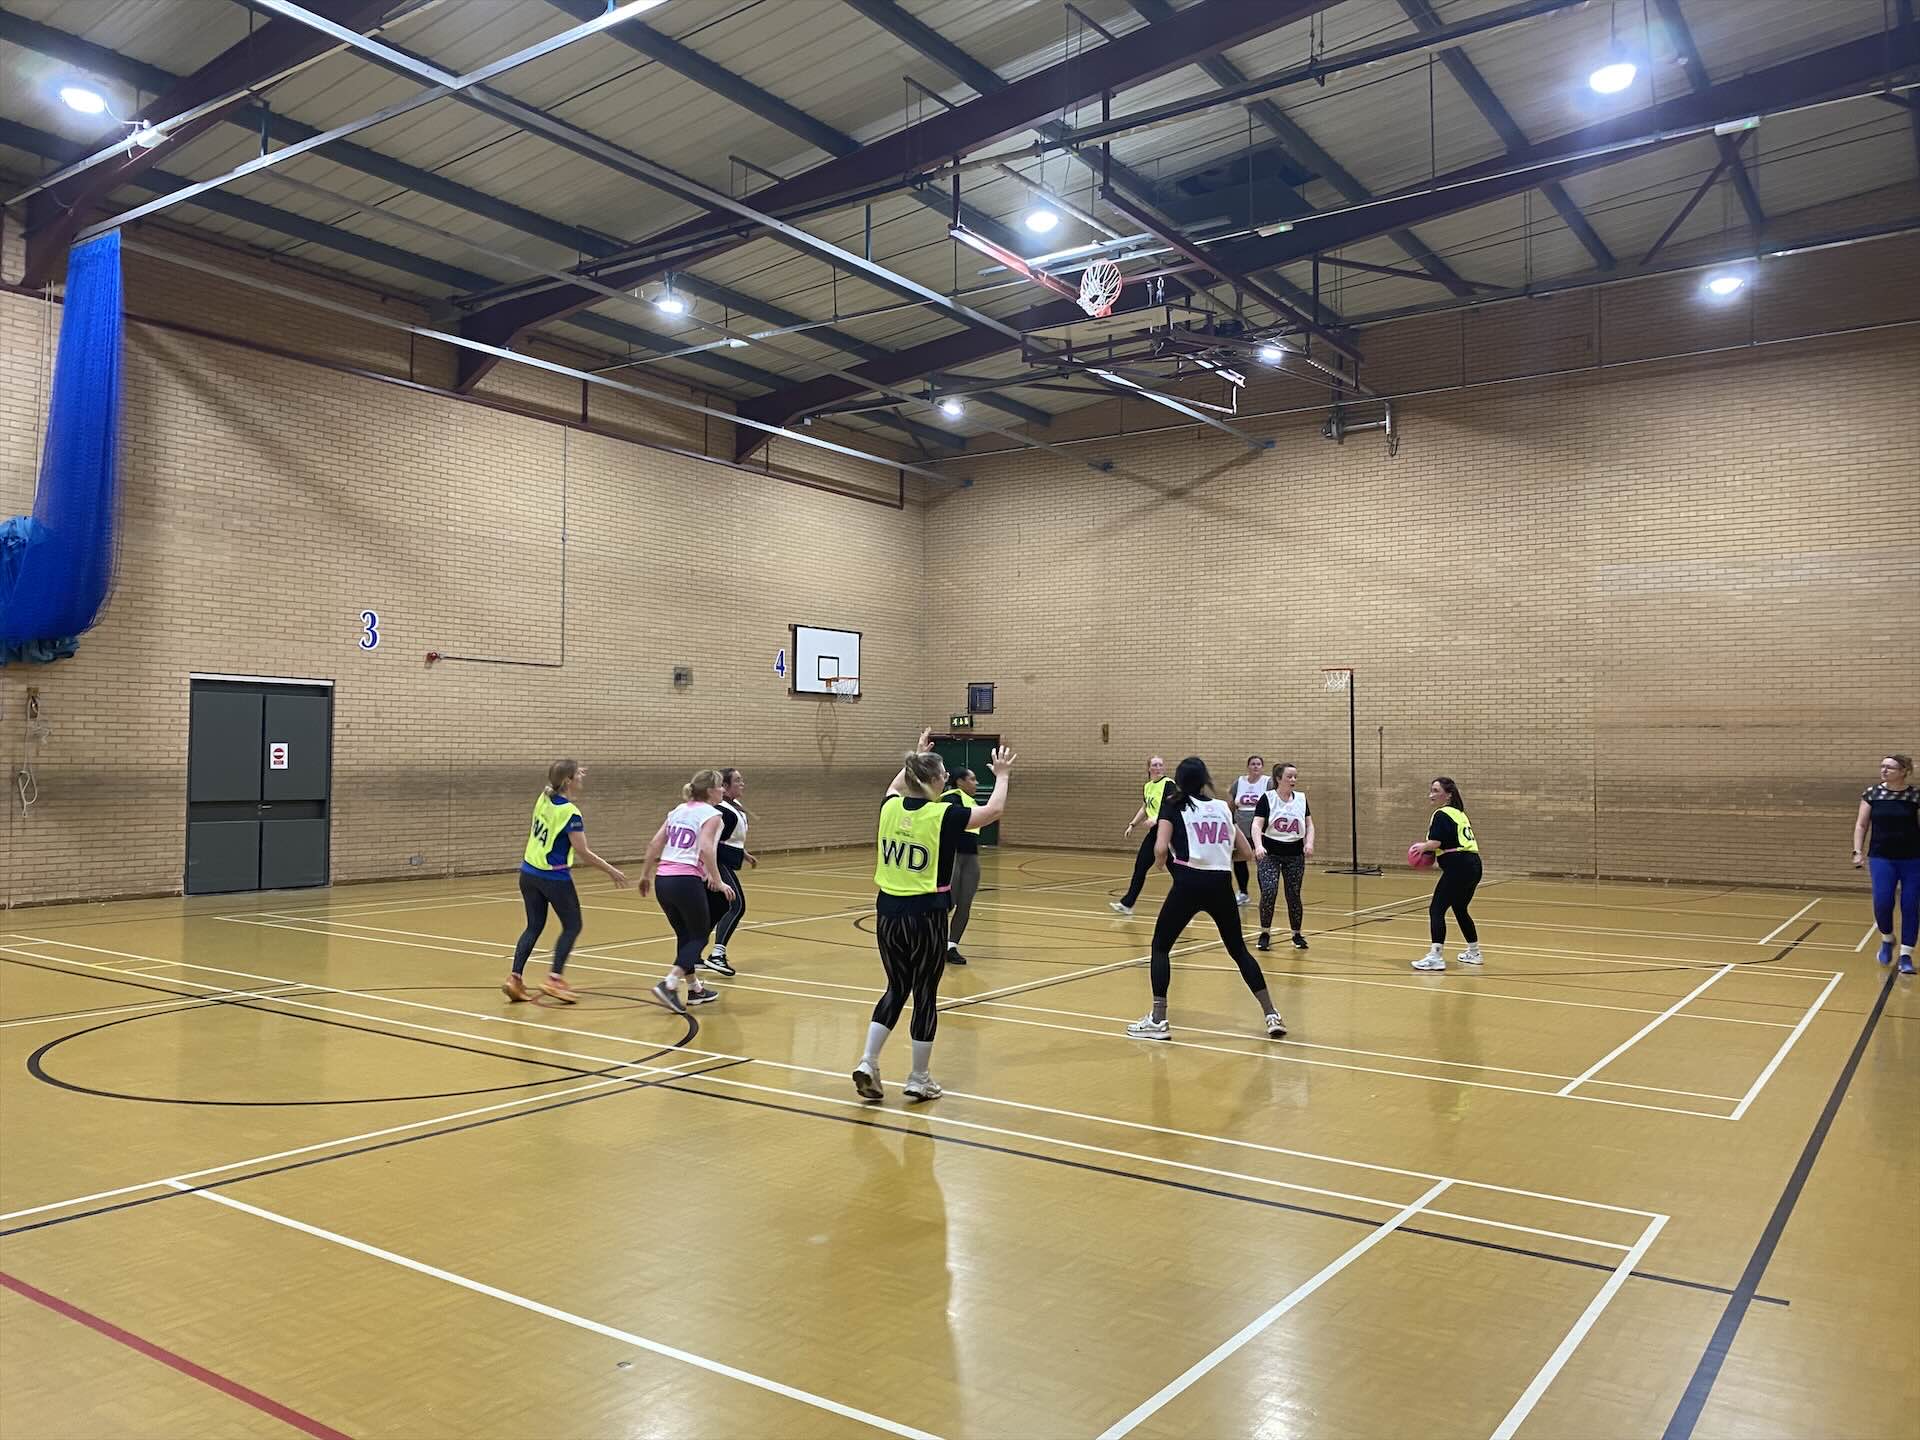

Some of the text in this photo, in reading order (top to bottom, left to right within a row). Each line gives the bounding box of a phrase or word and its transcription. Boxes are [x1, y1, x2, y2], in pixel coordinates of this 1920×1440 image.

[359, 609, 380, 650] 3
[774, 648, 786, 678] 4
[1239, 794, 1259, 806] GS
[665, 825, 697, 849] WD
[1192, 822, 1231, 846] WA
[1273, 816, 1300, 835] GA
[881, 838, 930, 872] WD
